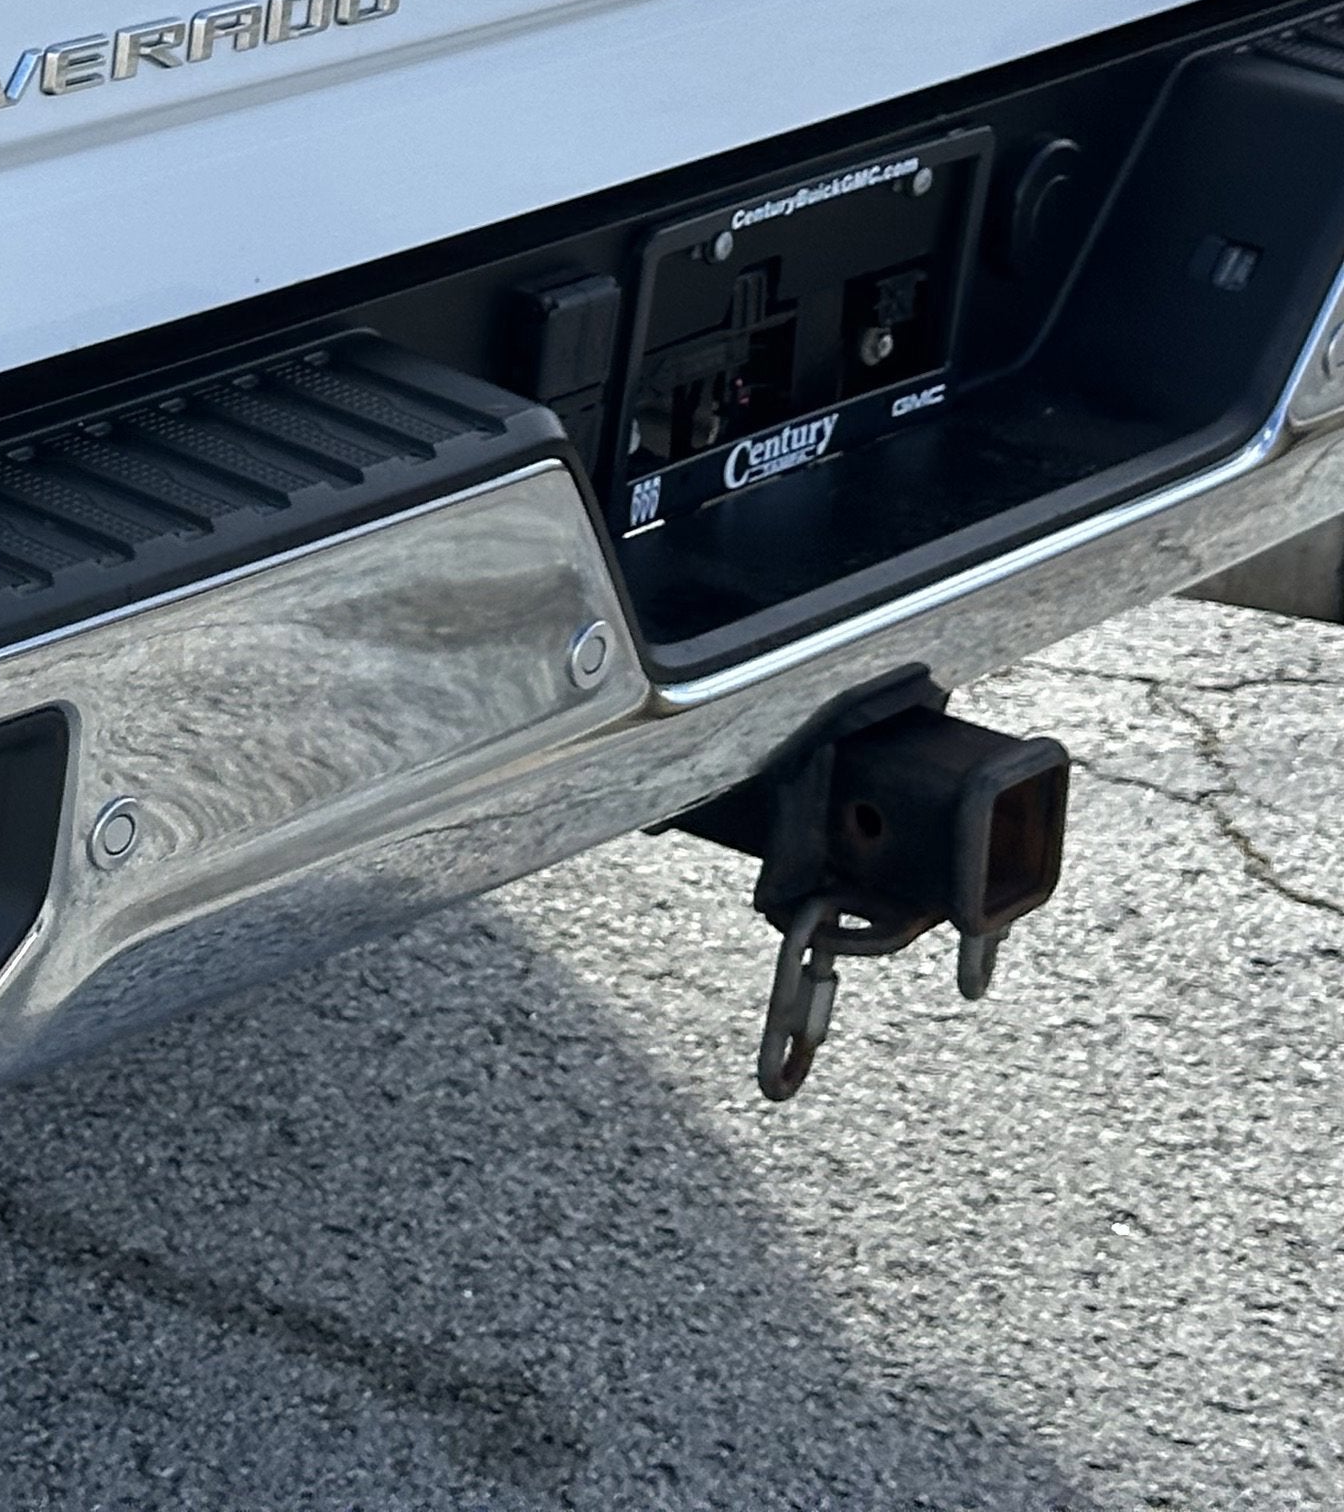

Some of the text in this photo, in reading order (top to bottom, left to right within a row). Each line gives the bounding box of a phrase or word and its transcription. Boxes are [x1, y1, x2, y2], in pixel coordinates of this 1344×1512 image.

[731, 157, 921, 230] CenturyBuickGMC.com
[892, 383, 946, 418] GMC
[723, 412, 840, 490] Century
